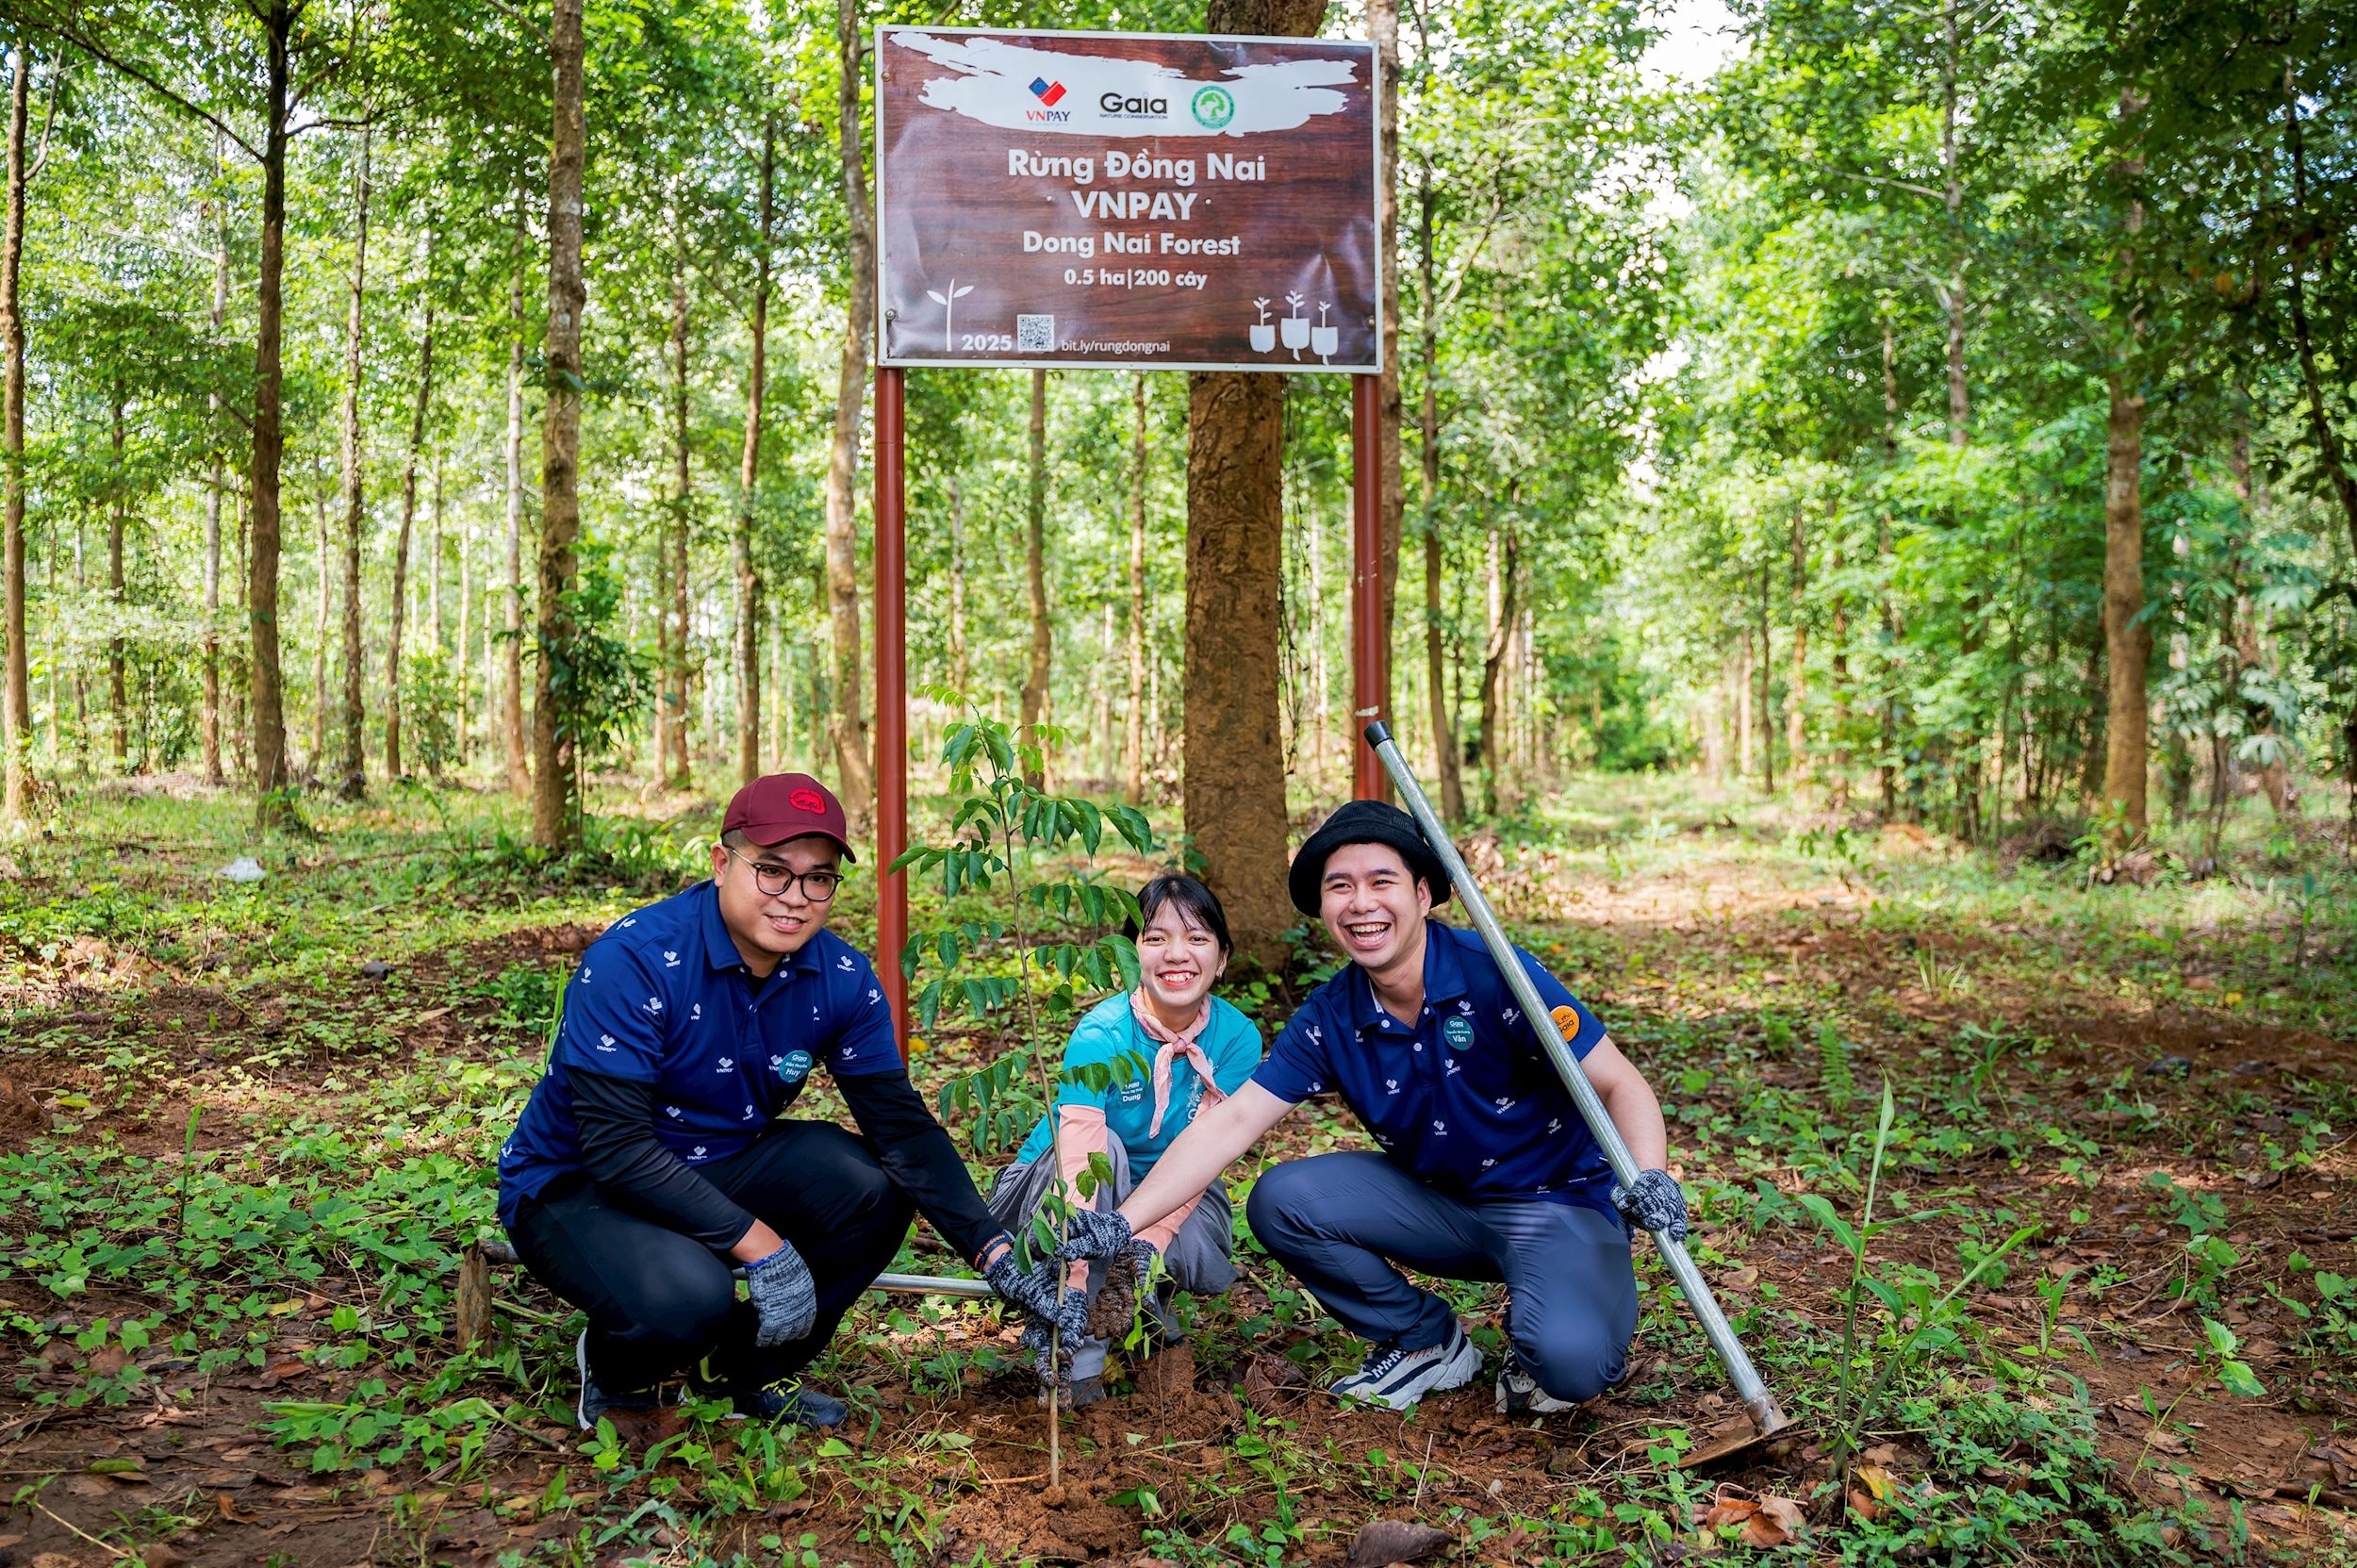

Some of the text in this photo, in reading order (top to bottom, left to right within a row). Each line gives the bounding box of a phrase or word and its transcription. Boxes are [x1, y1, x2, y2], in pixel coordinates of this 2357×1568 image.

[1100, 92, 1167, 114] Gaia
[1026, 110, 1071, 122] VNPAY
[1008, 148, 1266, 187] Rừng Đồng Nai
[1071, 190, 1198, 221] VNPAY
[1023, 231, 1241, 258] Dong Nai Forest
[1063, 269, 1095, 285] 0.5
[1175, 272, 1208, 290] cây
[962, 334, 1171, 355] 2025 bit.ly/rungdongnai
